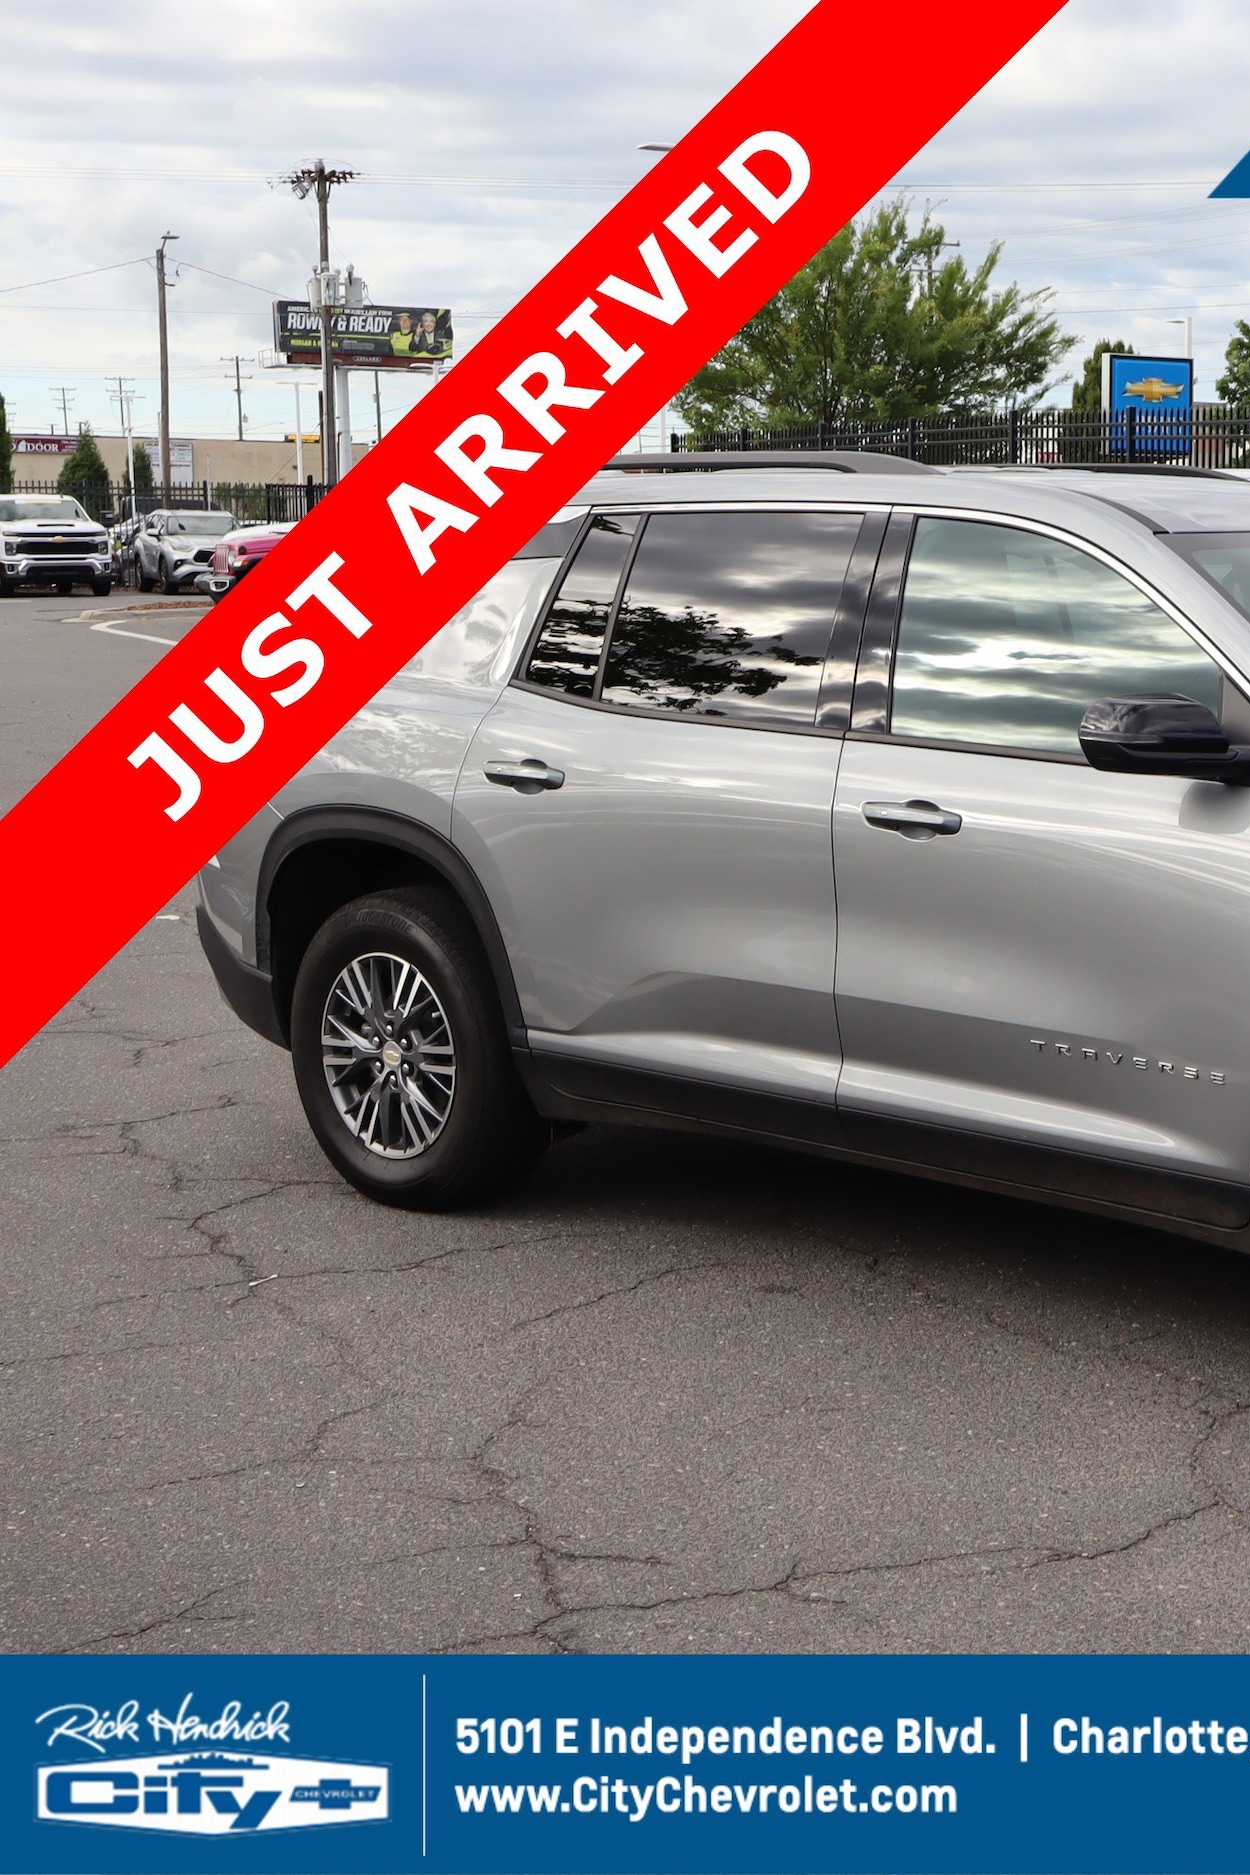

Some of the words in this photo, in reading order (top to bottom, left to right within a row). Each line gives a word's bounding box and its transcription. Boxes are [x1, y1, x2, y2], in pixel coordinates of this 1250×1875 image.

[287, 313, 336, 330] ROWY
[337, 315, 347, 331] &
[349, 316, 392, 333] READY
[27, 442, 59, 452] DOOR
[1029, 1039, 1226, 1085] TRAVERSE
